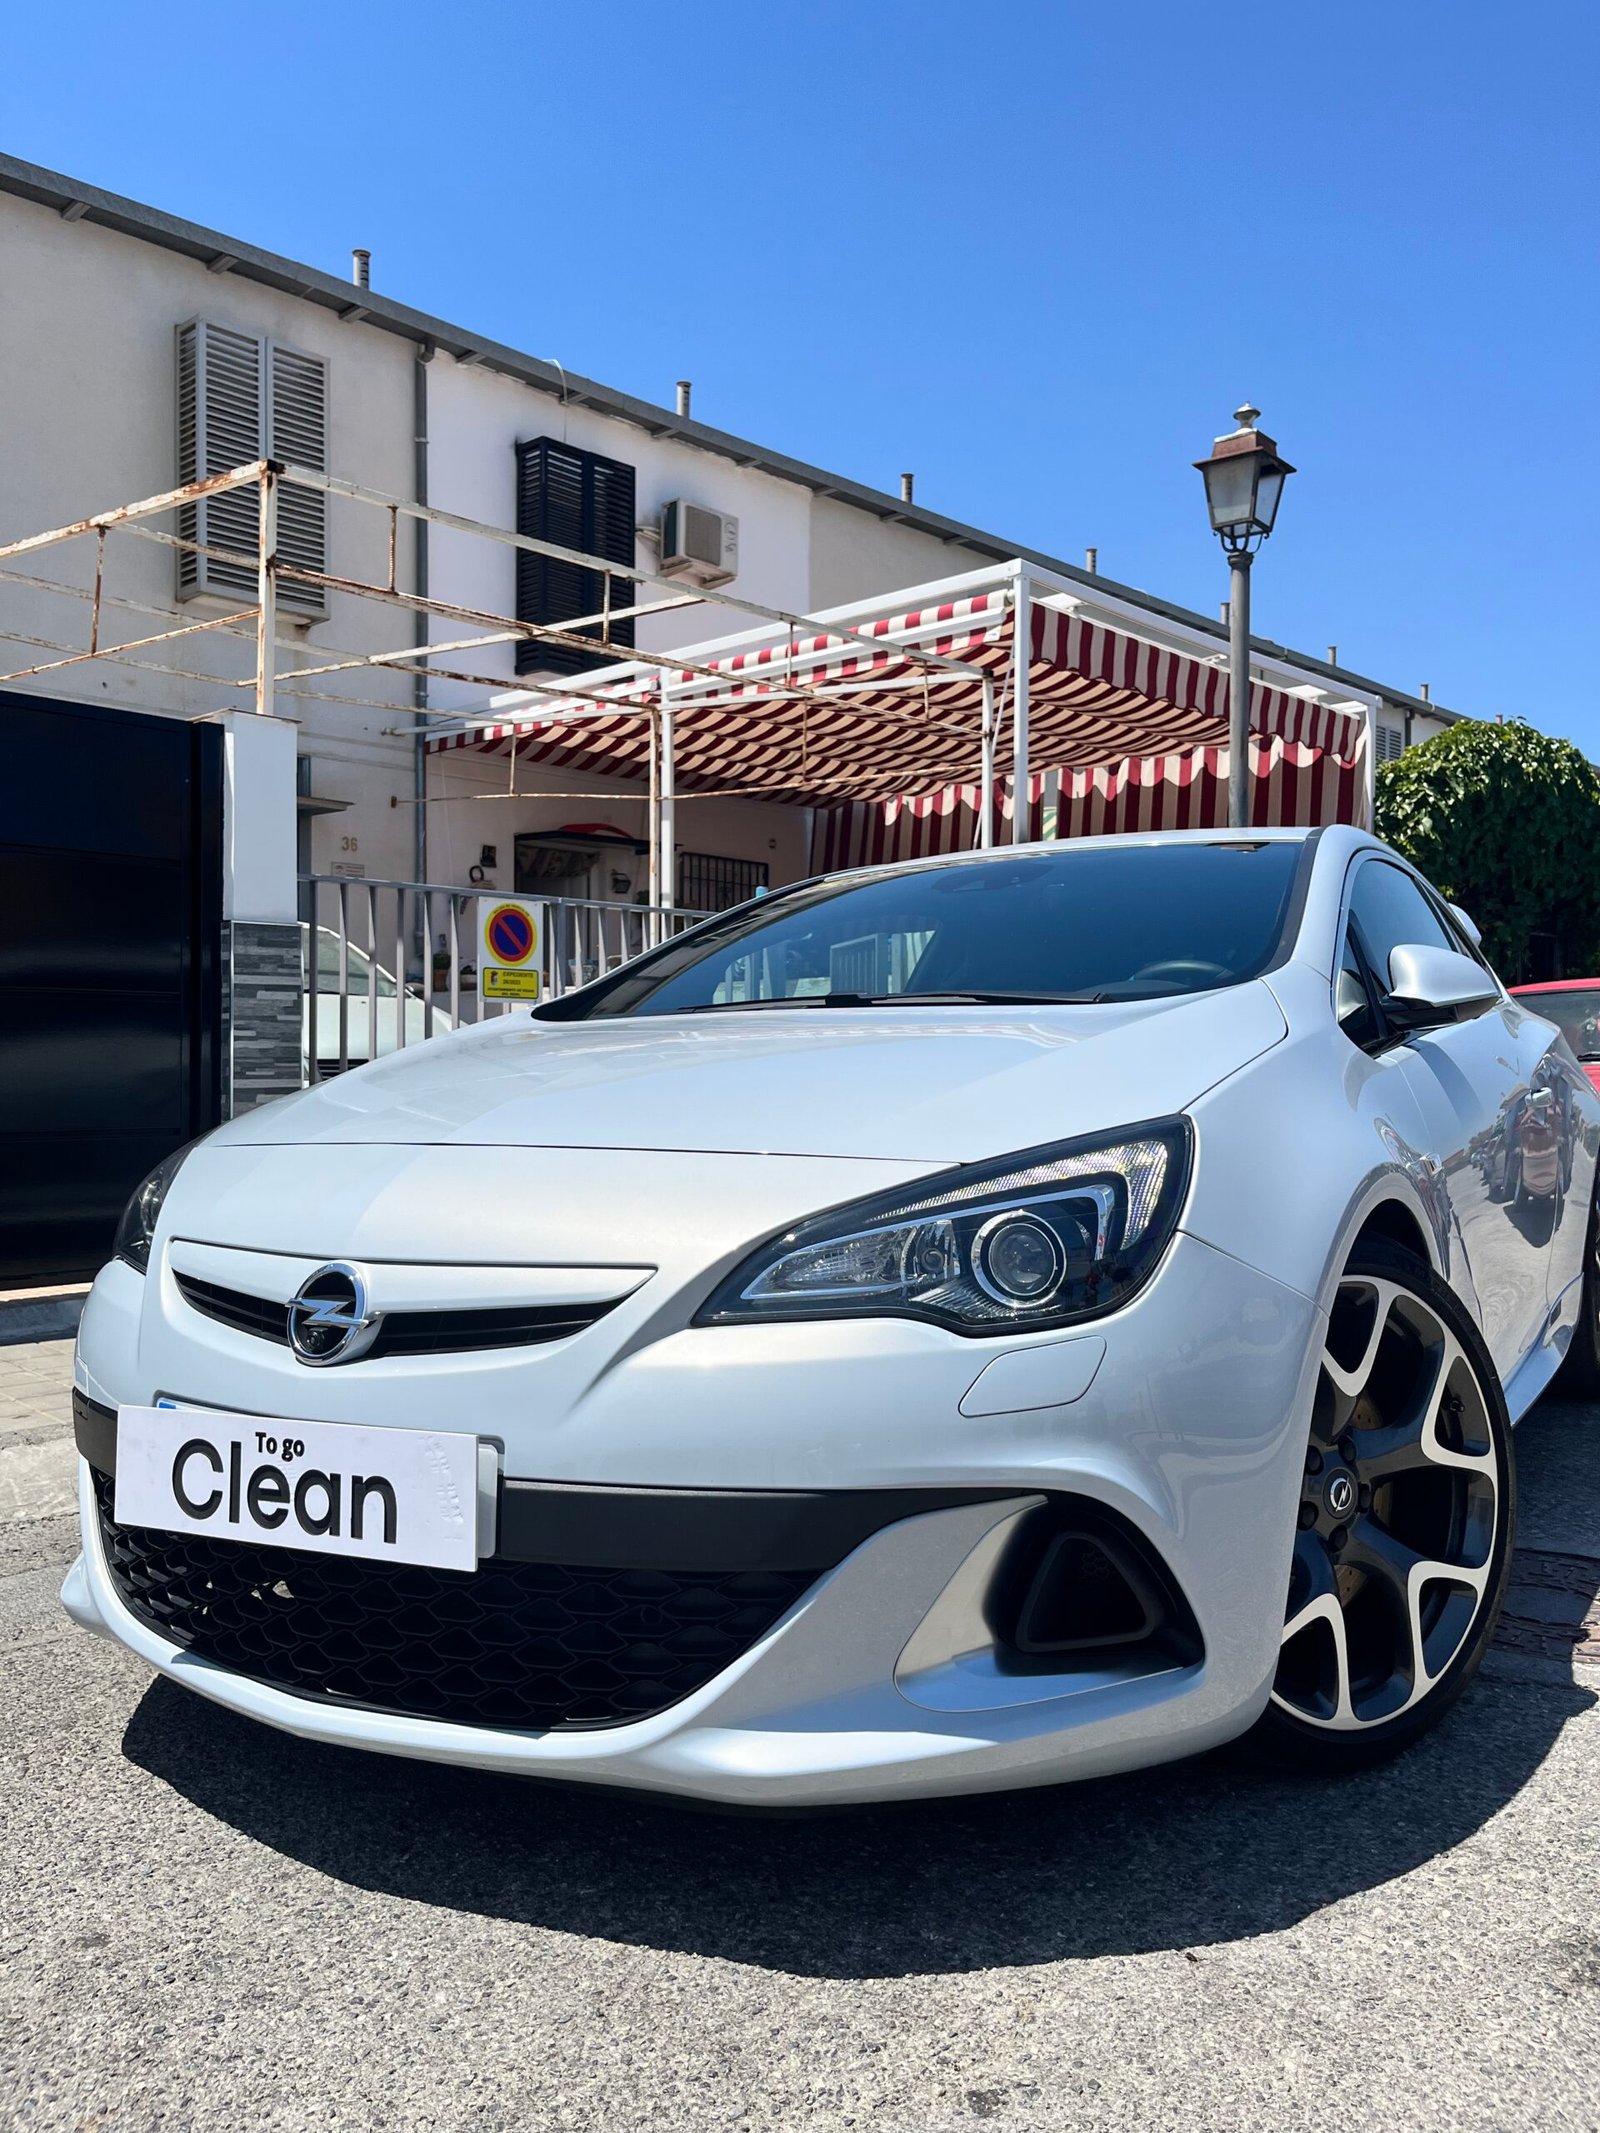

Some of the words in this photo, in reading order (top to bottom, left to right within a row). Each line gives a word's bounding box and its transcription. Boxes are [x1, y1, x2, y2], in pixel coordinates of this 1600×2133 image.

[341, 836, 358, 852] 36
[255, 1431, 277, 1455] To
[281, 1438, 305, 1462] go
[171, 1438, 398, 1544] Clean
